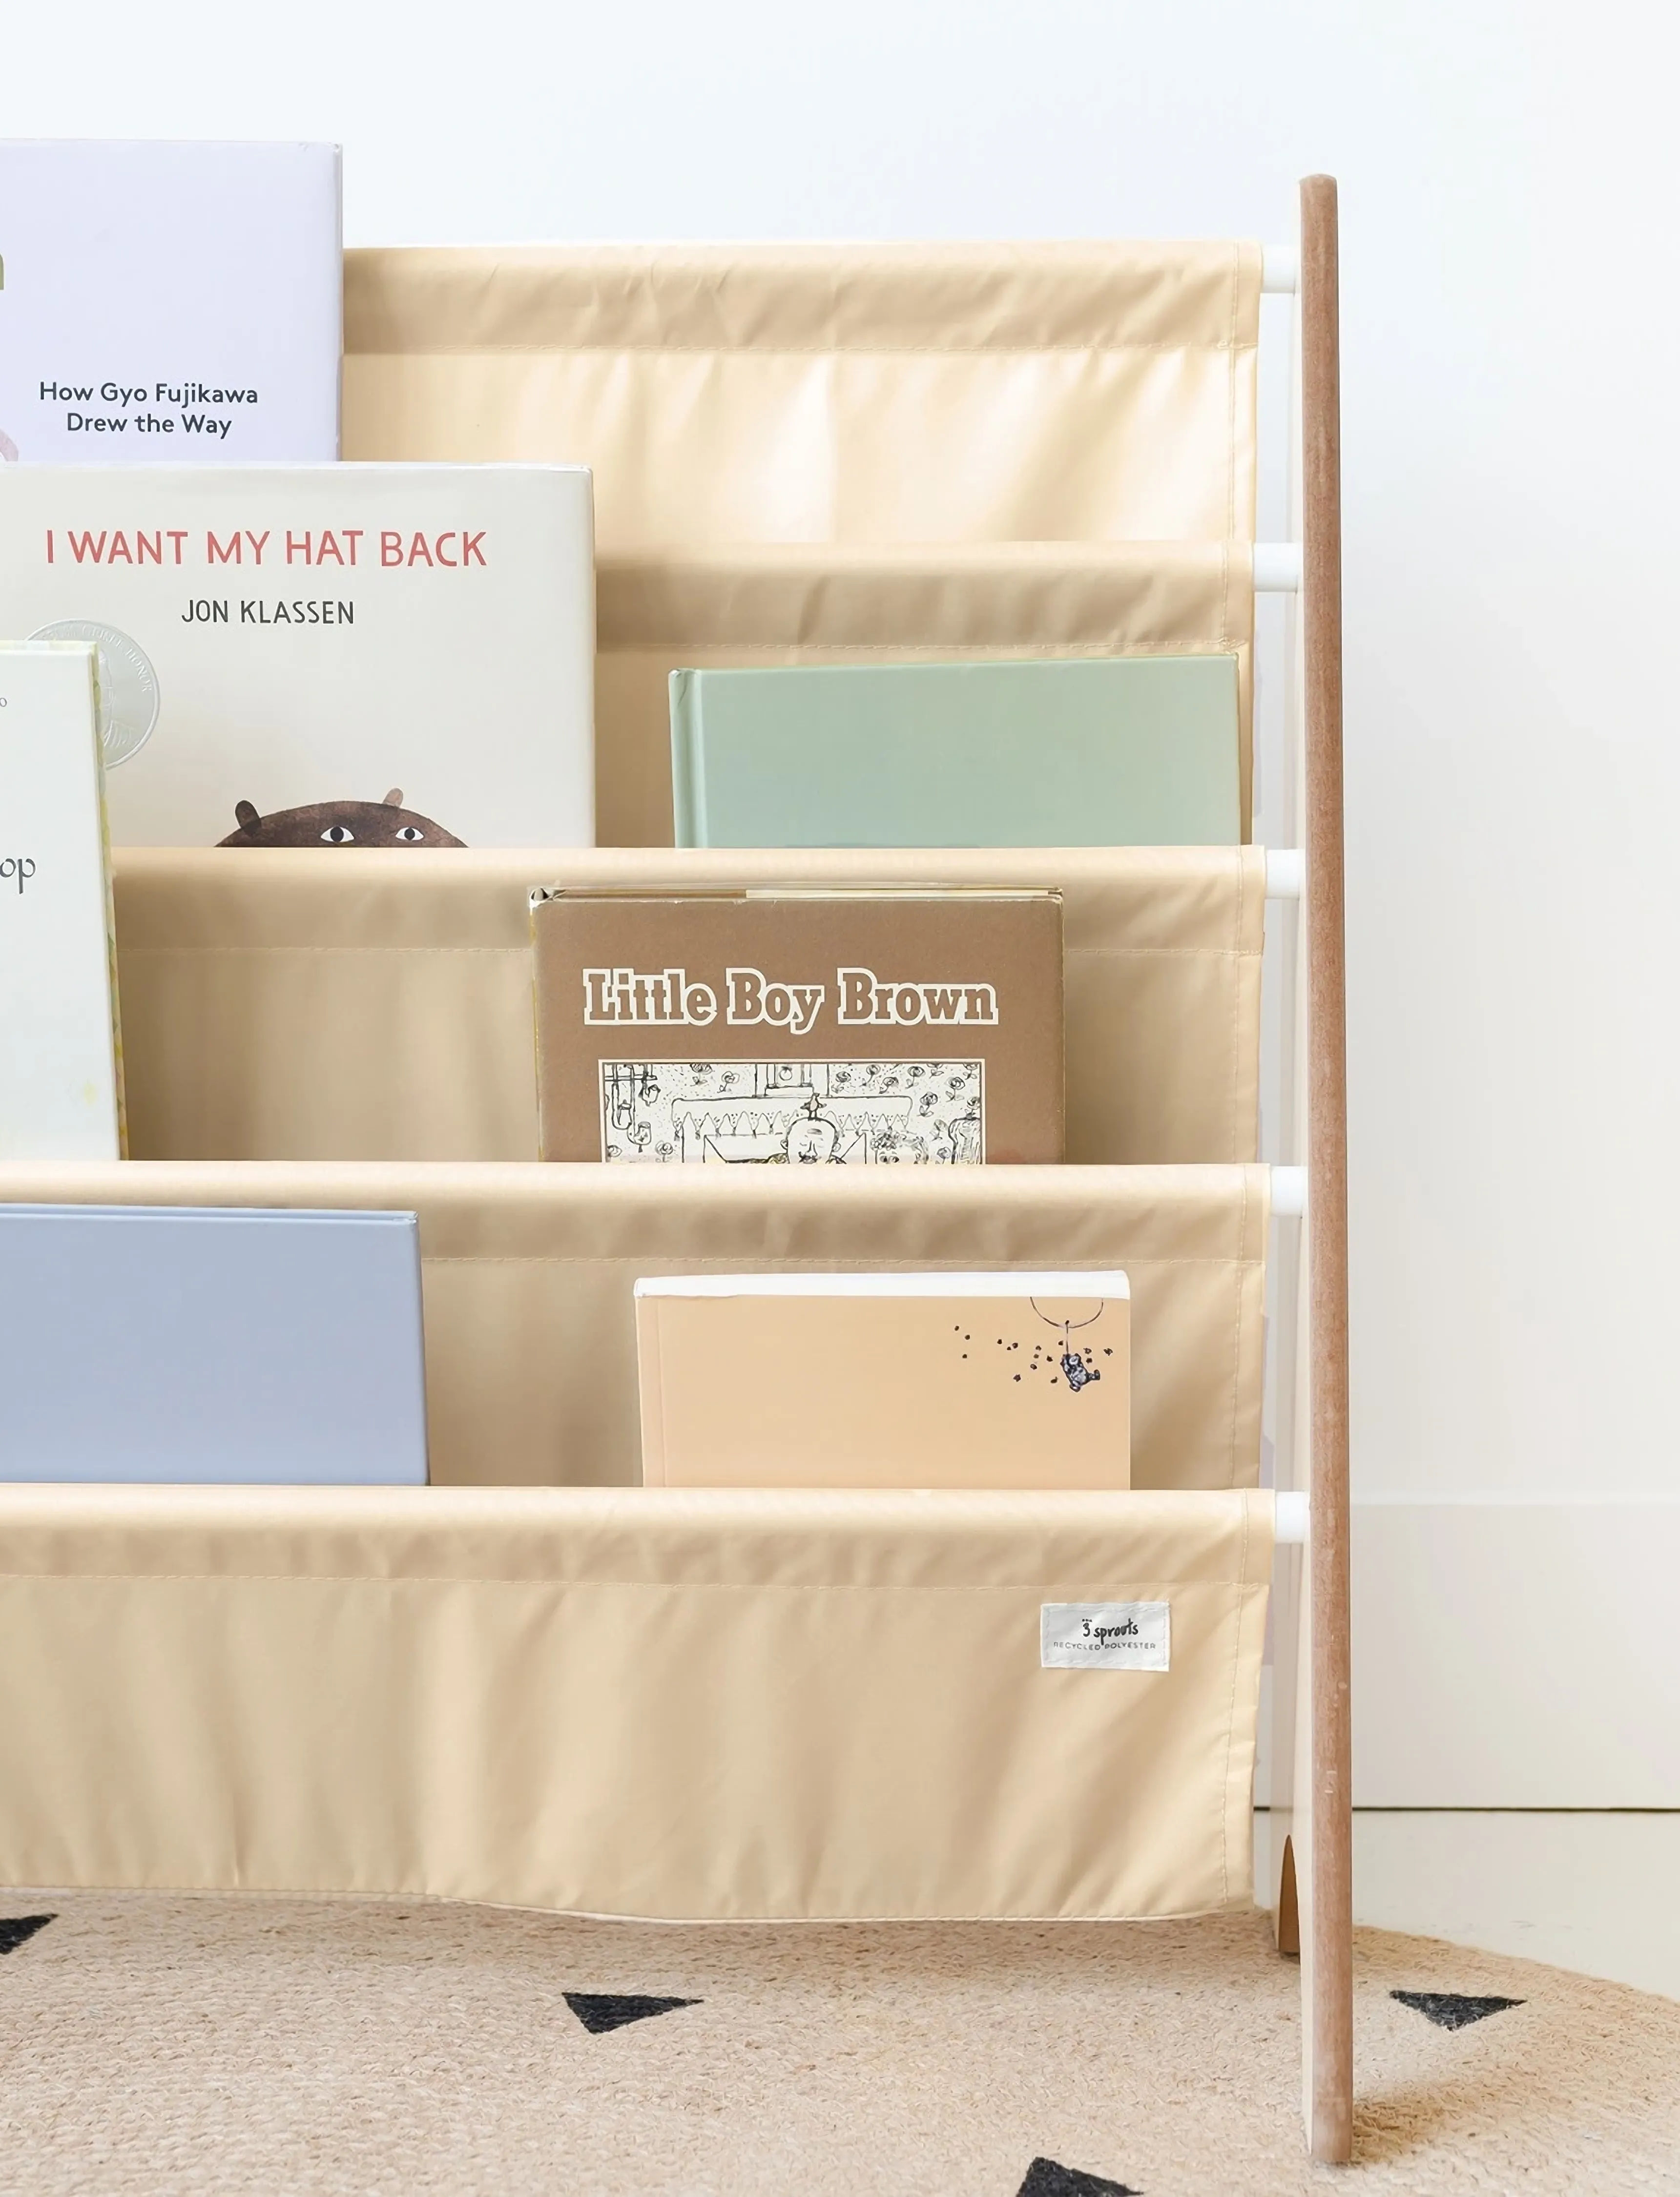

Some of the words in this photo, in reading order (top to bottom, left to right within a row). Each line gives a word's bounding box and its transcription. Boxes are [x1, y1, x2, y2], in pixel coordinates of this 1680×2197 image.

[40, 381, 94, 401] How
[101, 382, 147, 408] Gyo
[156, 382, 258, 408] Fujikawa
[67, 413, 128, 432] Drew
[134, 413, 174, 433] the
[181, 414, 232, 439] Way
[47, 530, 54, 563] I
[67, 531, 188, 564] WANT
[207, 531, 270, 565] MY
[286, 530, 364, 565] HAT
[380, 531, 487, 567] BACK
[181, 600, 228, 622] JON
[241, 600, 353, 624] KLASSEN
[583, 968, 717, 1026] Little
[726, 968, 825, 1035] Boy
[837, 968, 999, 1026] Brown
[1093, 1617, 1139, 1645] sprouts
[1053, 1641, 1100, 1651] RECYCLED
[1104, 1641, 1156, 1650] POLYESTER
